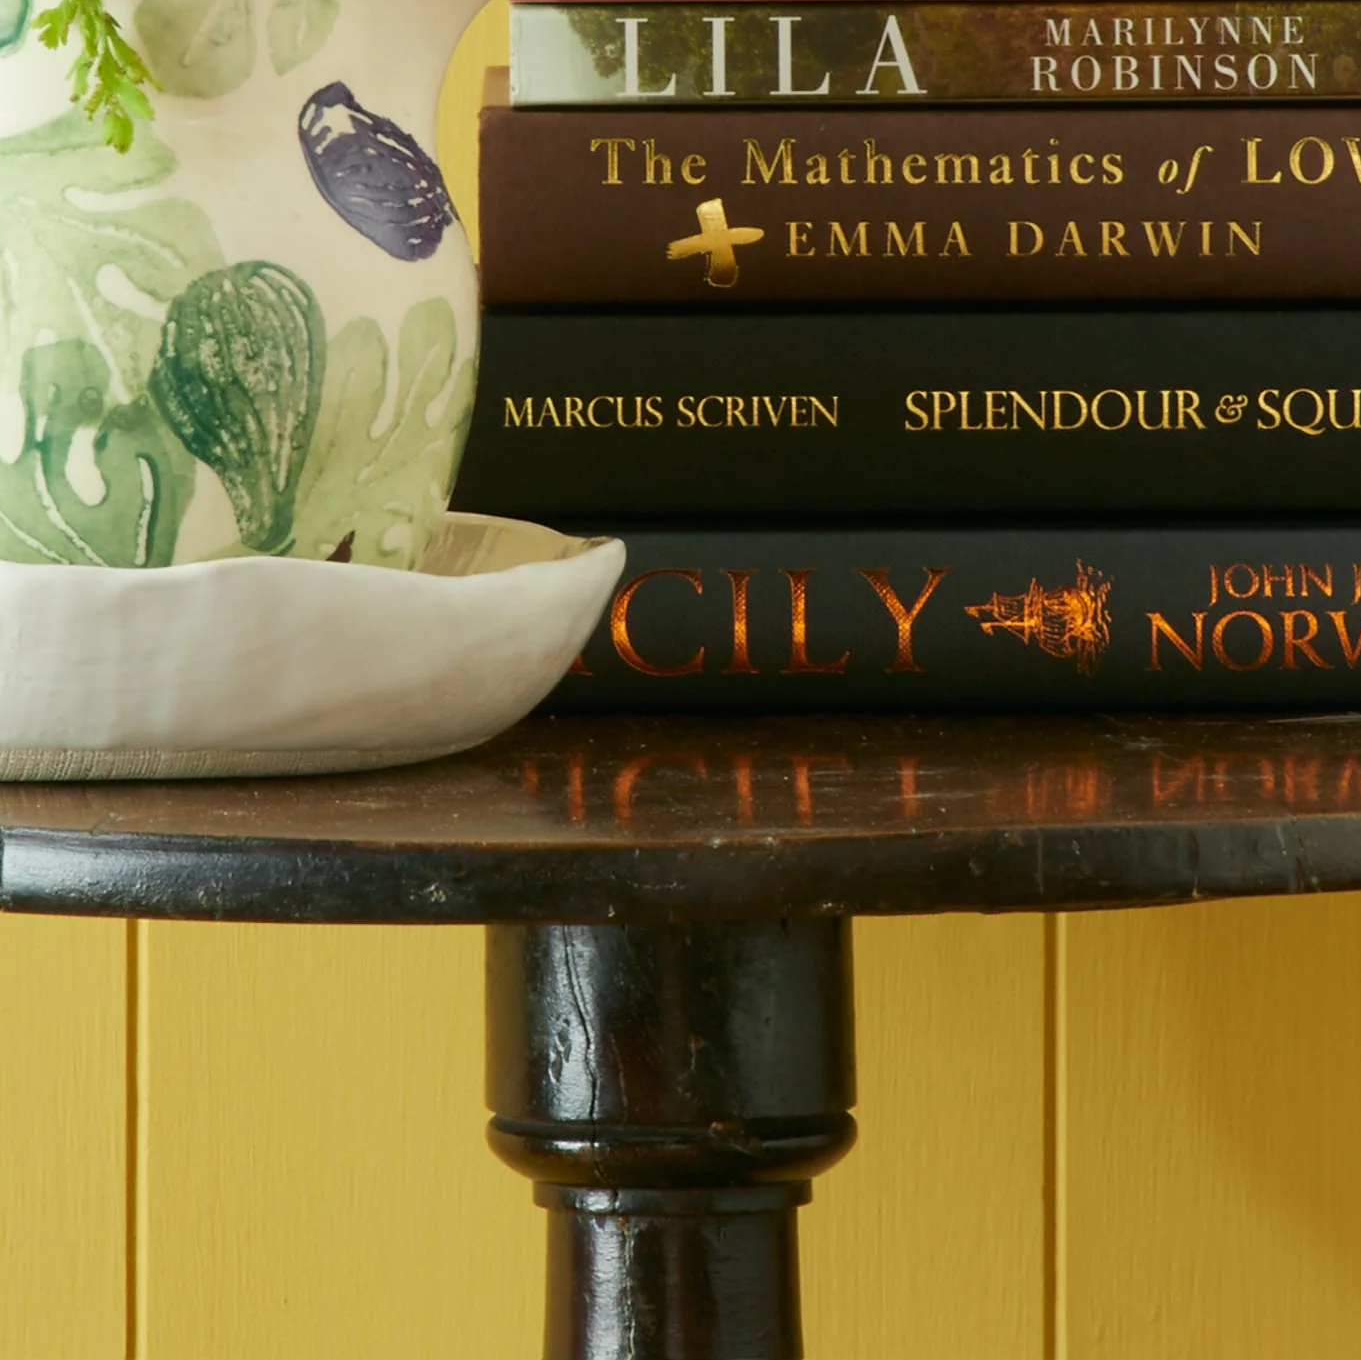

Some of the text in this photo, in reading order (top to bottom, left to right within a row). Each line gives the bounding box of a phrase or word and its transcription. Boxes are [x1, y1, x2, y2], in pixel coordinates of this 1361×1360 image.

[1044, 15, 1305, 47] MARILYNNE
[616, 14, 928, 97] LILA
[1030, 53, 1319, 92] ROBINSON
[590, 138, 708, 184] The
[742, 138, 1124, 185] Mathematics
[1157, 145, 1214, 195] of
[785, 220, 1263, 258] EMMA DARWIN
[503, 394, 840, 429] MARCUS SCRIVEN
[1207, 562, 1334, 607] JOHN
[567, 568, 954, 676] CILY
